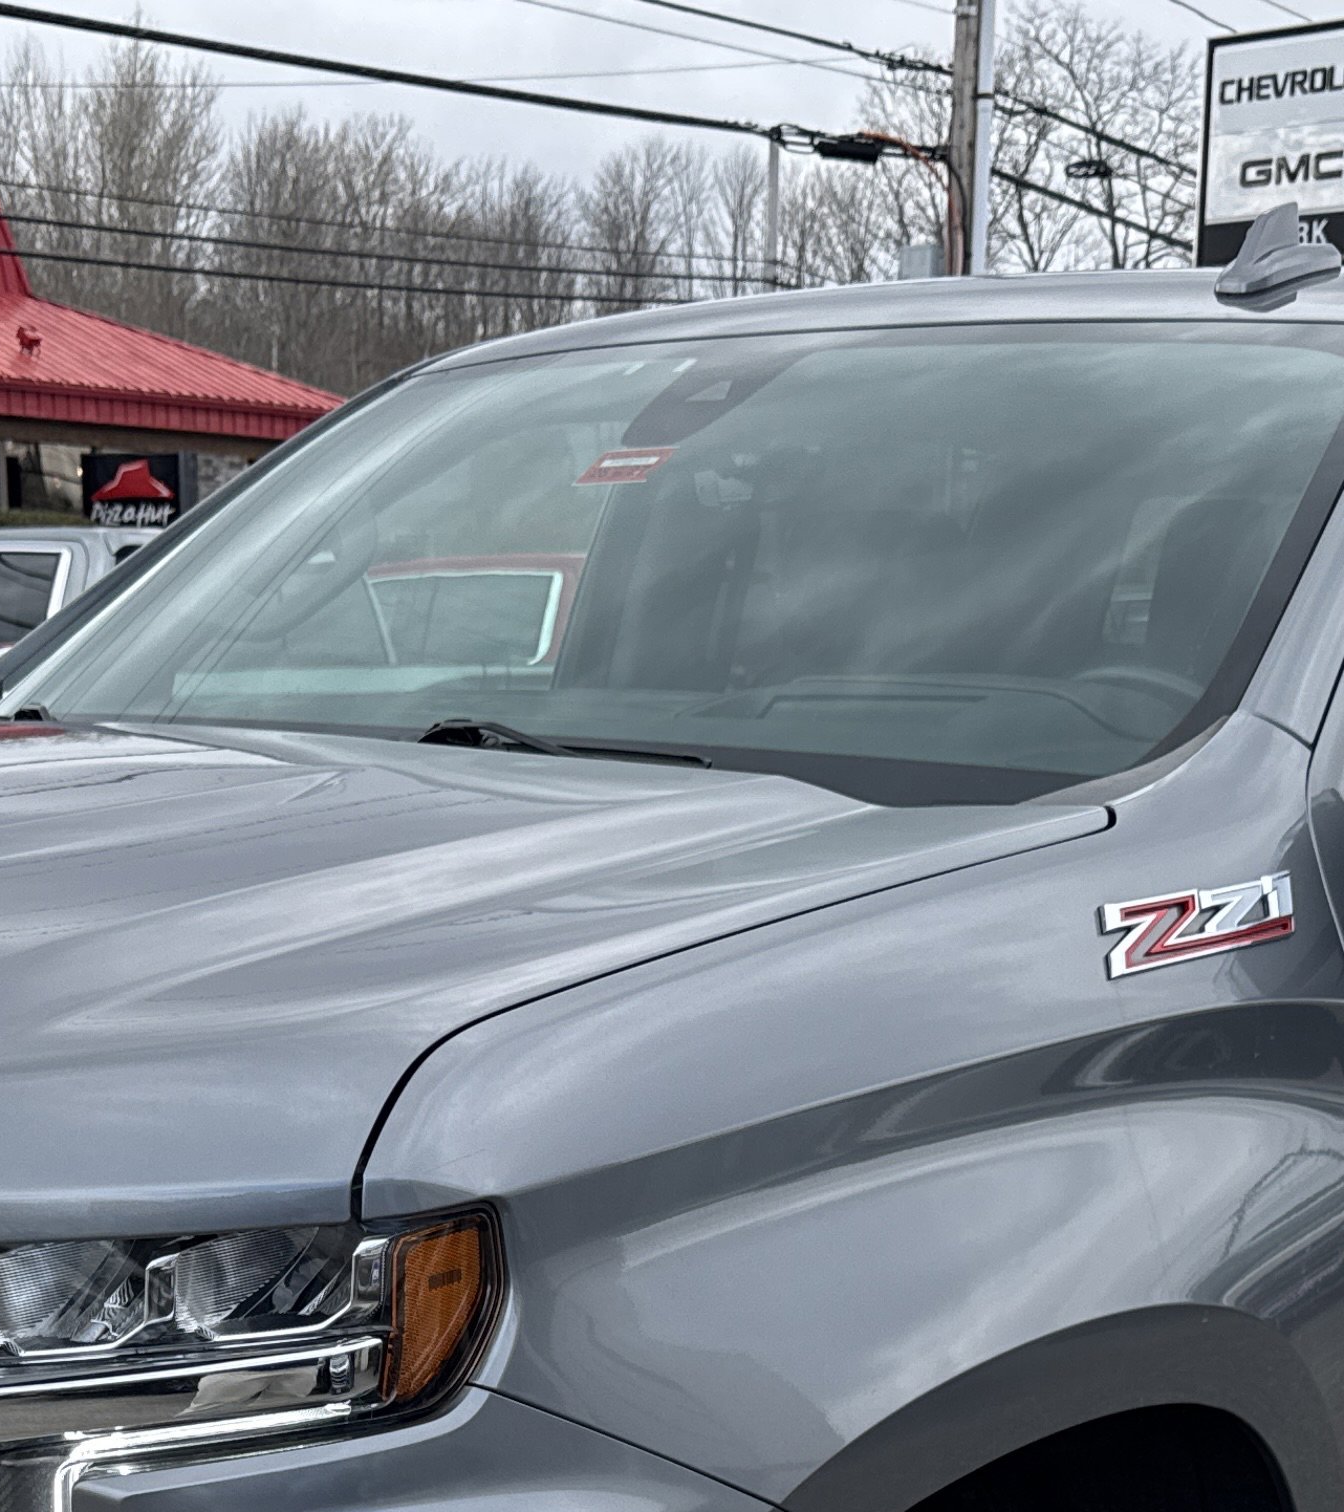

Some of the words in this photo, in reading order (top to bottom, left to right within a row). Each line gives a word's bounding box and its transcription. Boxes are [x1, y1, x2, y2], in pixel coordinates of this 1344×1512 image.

[1239, 149, 1344, 188] GMC
[1298, 218, 1329, 243] RK
[1097, 870, 1295, 980] Z71
